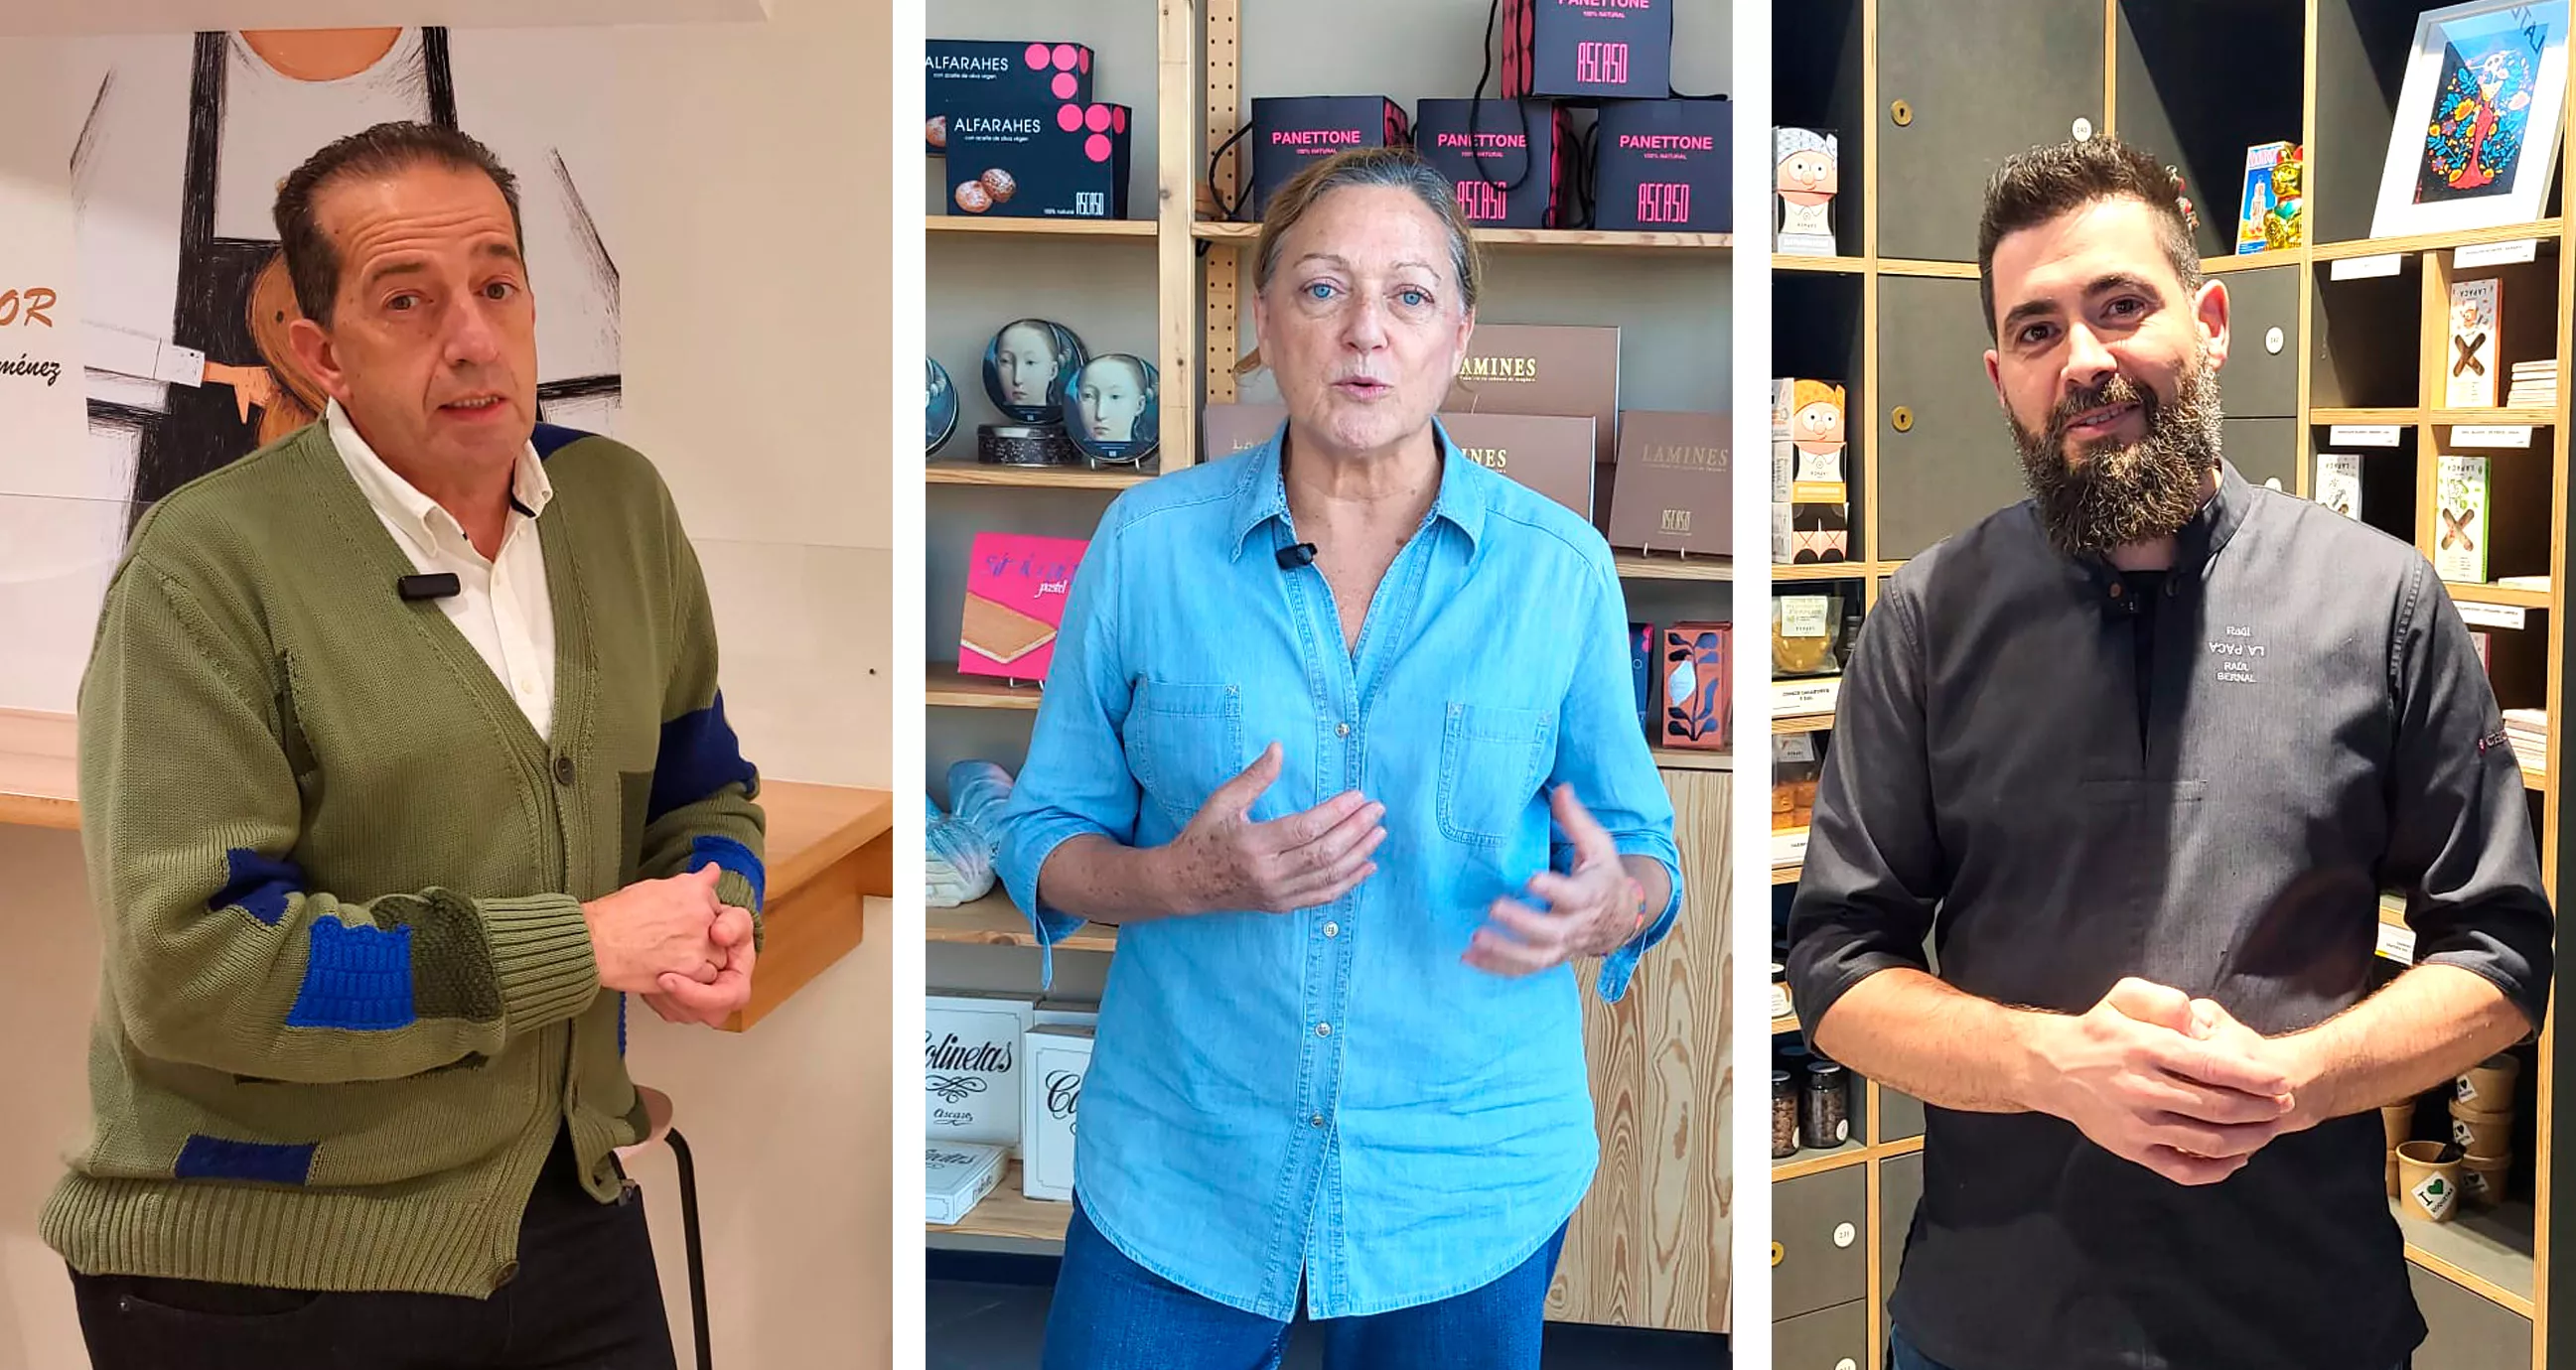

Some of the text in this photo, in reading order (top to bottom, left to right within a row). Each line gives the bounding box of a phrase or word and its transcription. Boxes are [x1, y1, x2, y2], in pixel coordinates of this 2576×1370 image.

[925, 56, 1009, 71] ALFARAHES
[1576, 42, 1629, 83] ASCASO
[954, 117, 1041, 133] ALFARAHES
[1272, 130, 1360, 145] PANETTONE
[1620, 134, 1714, 150] PANETTONE
[1637, 183, 1690, 223] ASCASO
[1461, 357, 1536, 376] AMINES
[1462, 448, 1506, 468] INES
[1642, 444, 1729, 467] LAMINES
[2208, 641, 2265, 656] LA PACA
[2217, 672, 2258, 683] BERNAL
[926, 1028, 1013, 1073] olinetas
[2418, 1190, 2433, 1207] I
